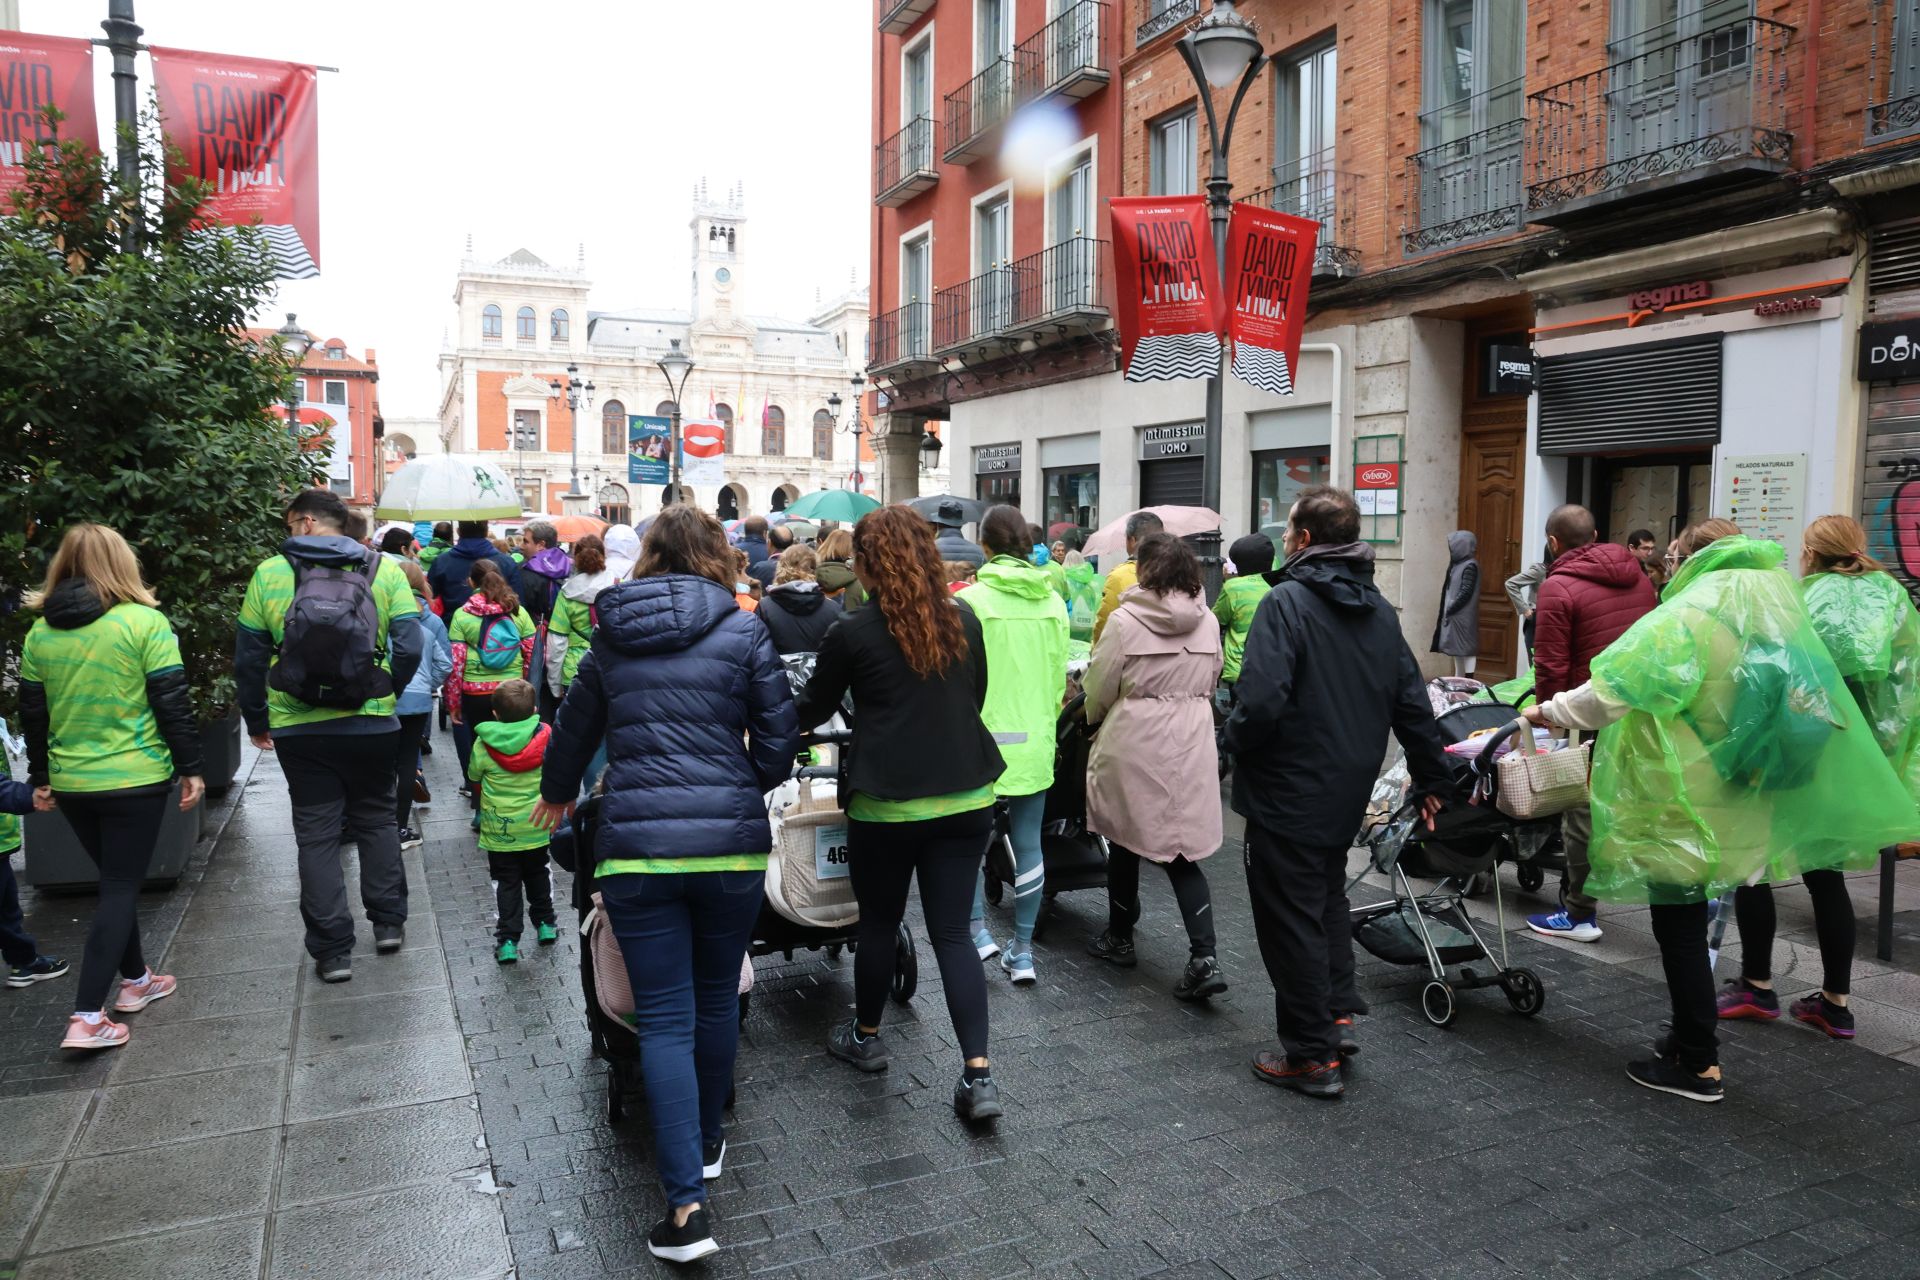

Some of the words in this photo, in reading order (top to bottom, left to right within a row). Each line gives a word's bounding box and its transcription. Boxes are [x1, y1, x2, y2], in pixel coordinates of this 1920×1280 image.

[192, 82, 287, 142] DAVID
[199, 135, 286, 193] LYNCH
[1136, 221, 1197, 263] DAVID
[1242, 232, 1297, 281] DAVID
[1140, 260, 1206, 304] LYNCH
[1236, 272, 1291, 320] LYNCH
[1626, 280, 1708, 311] regma
[1500, 360, 1531, 373] regma
[1144, 424, 1205, 441] intimissimi
[1160, 442, 1187, 454] UOMO
[979, 446, 1020, 459] intimissimi
[988, 460, 1006, 469] UOMO
[1365, 471, 1388, 480] SVENSON
